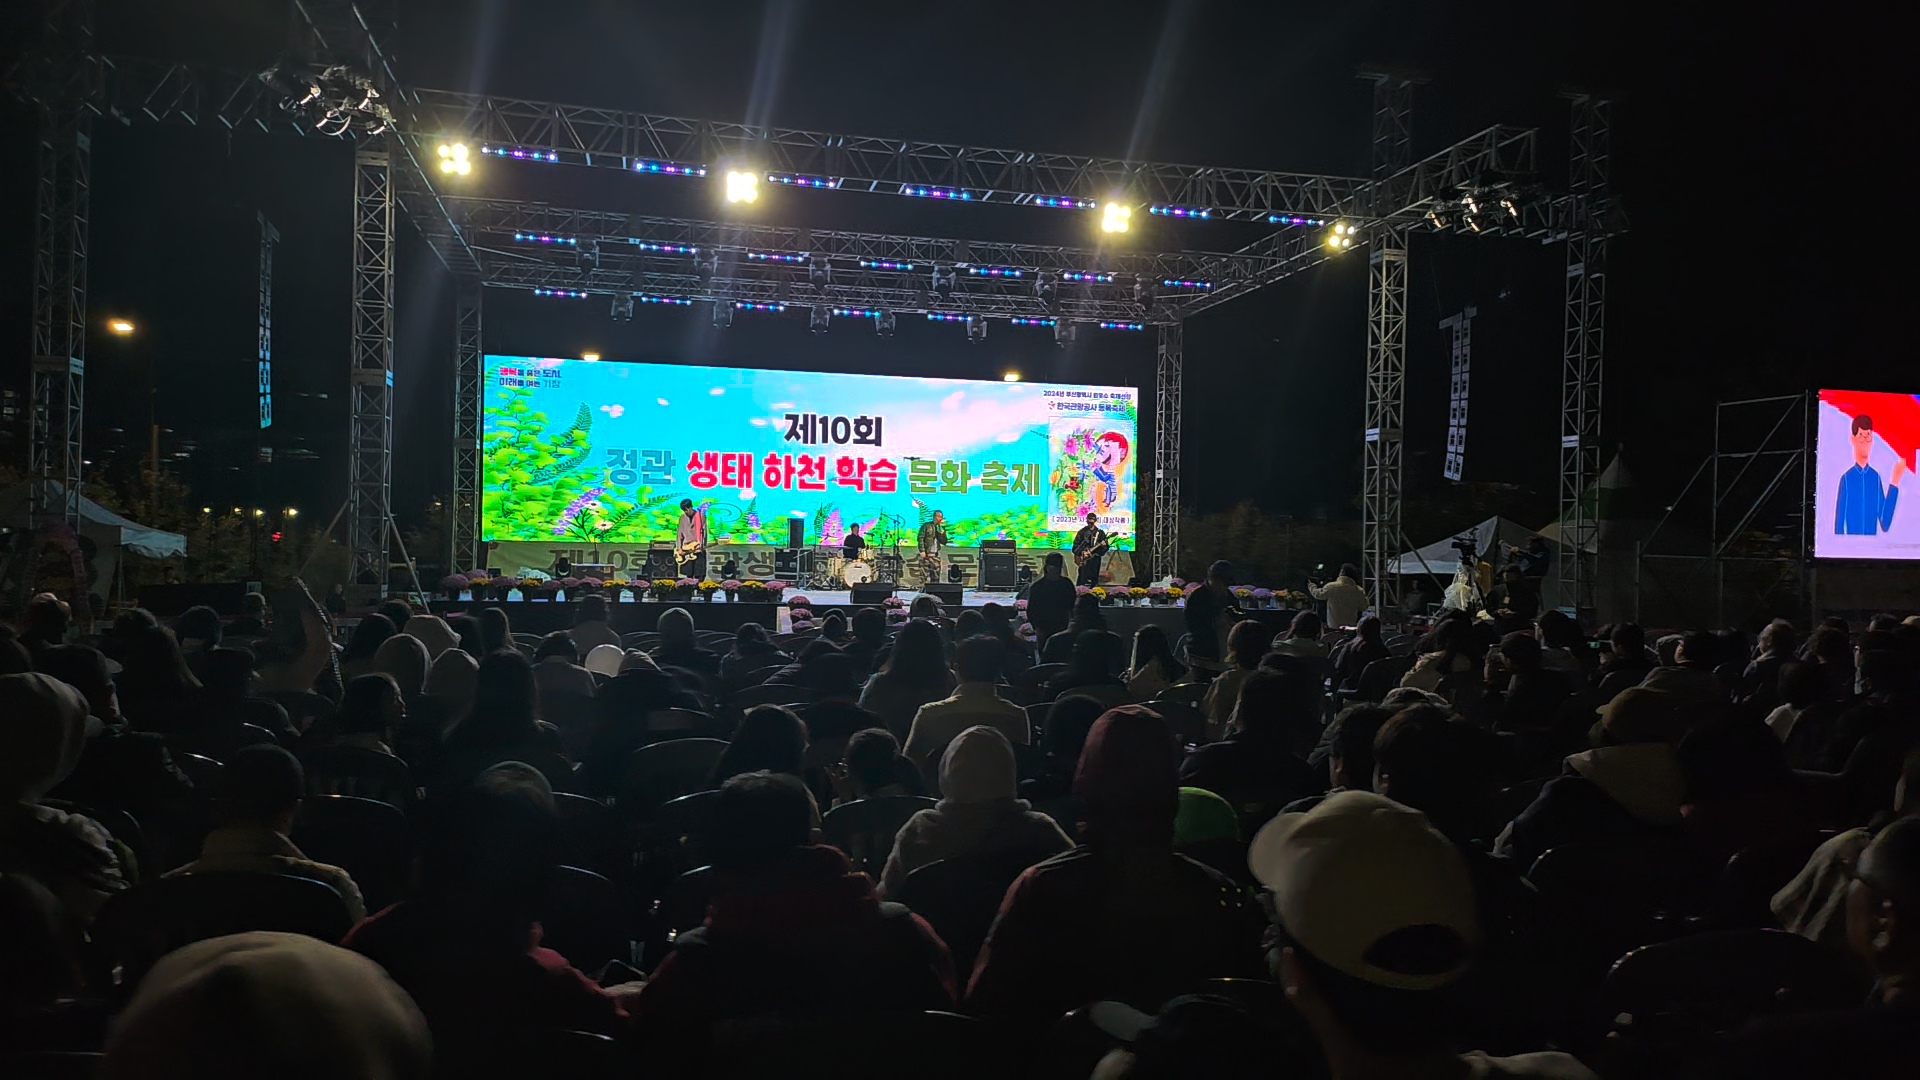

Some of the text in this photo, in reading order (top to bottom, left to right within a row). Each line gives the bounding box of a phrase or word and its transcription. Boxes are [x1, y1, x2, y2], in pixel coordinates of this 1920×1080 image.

[784, 413, 883, 447] 제10회
[606, 449, 1040, 496] 정관 생태 하천 학습 문화 축제
